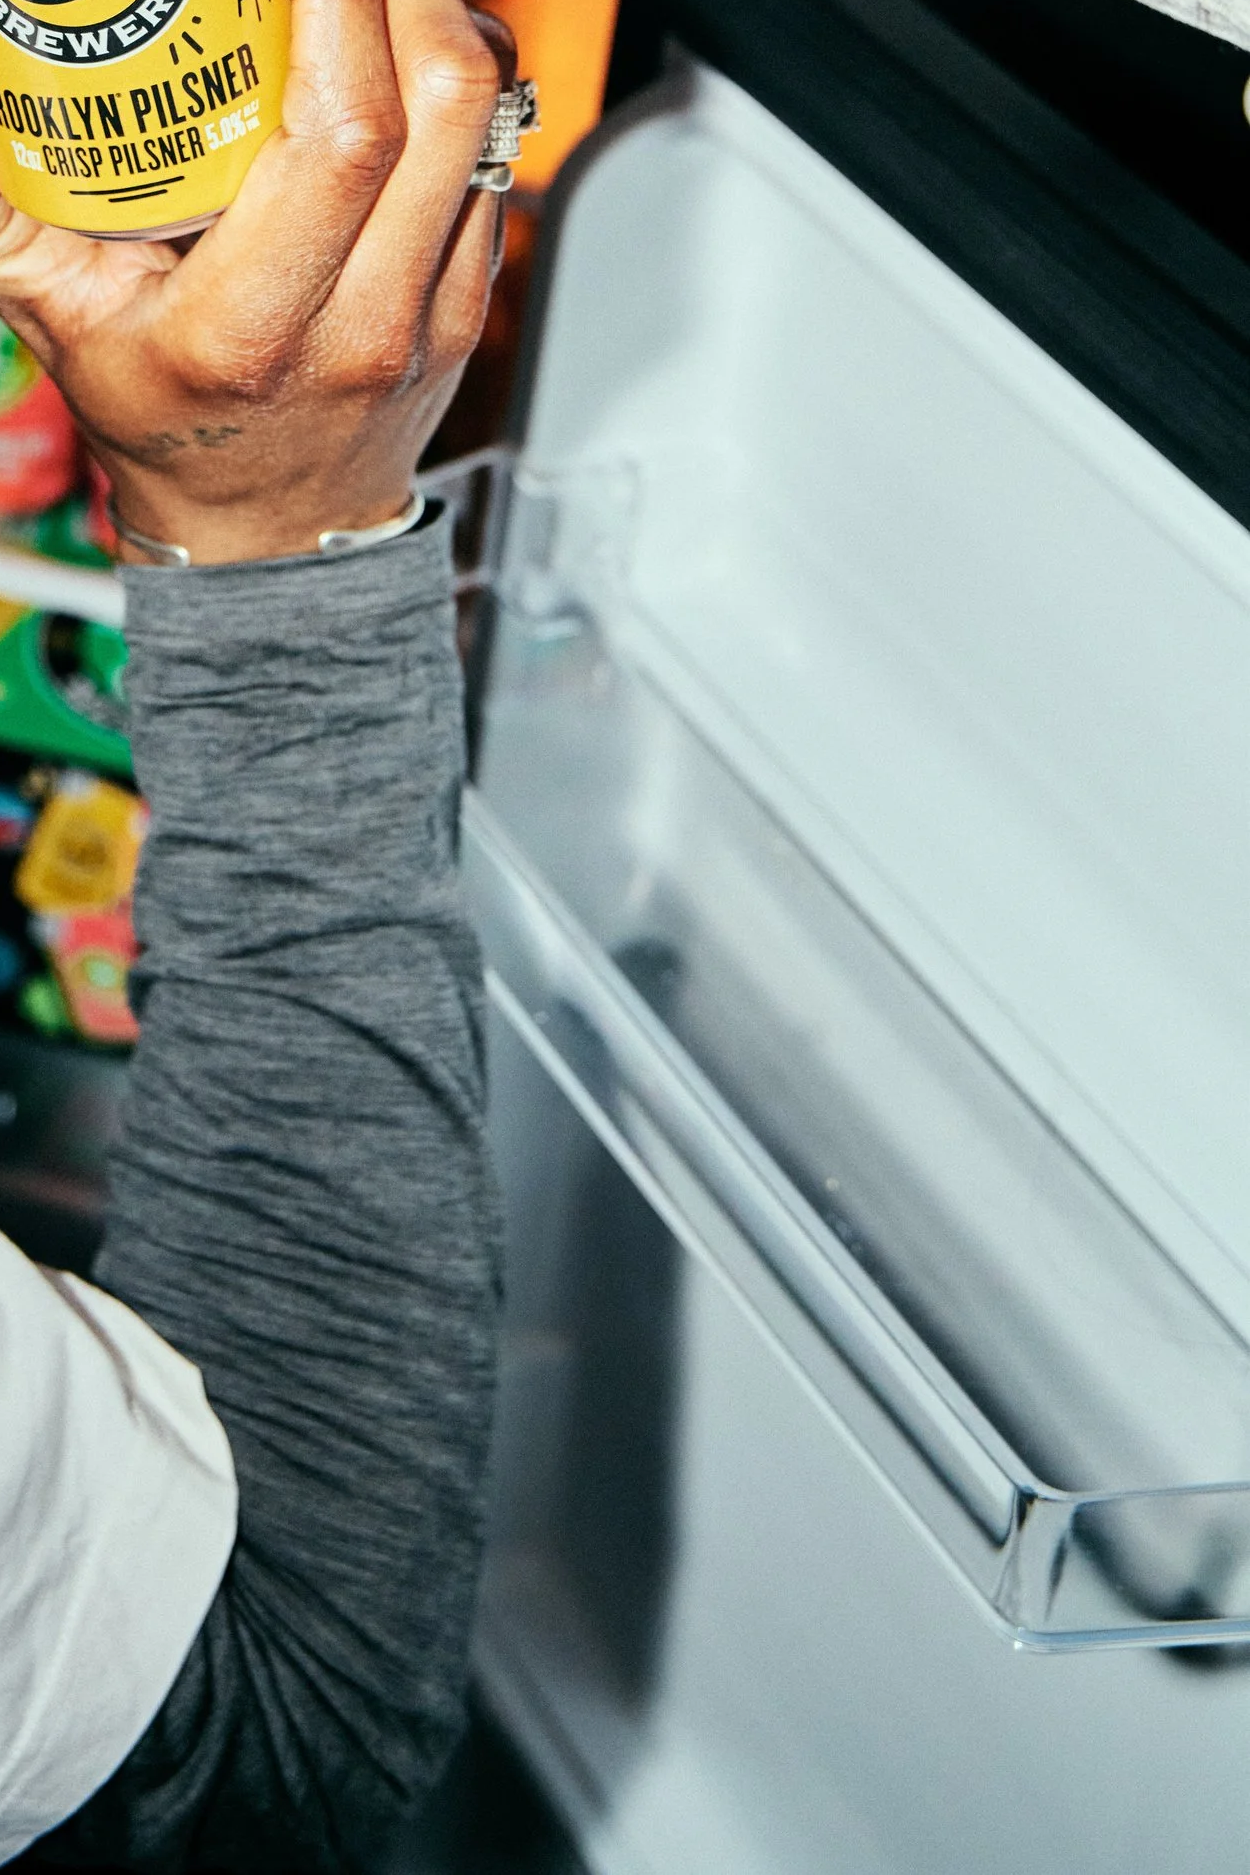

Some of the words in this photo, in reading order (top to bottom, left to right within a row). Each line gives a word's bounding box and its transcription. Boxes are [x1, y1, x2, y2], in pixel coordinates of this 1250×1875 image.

[130, 43, 260, 134] PILSNER
[42, 144, 103, 178] CRISP
[108, 126, 206, 177] PILSNER
[204, 109, 247, 151] 5.0%
